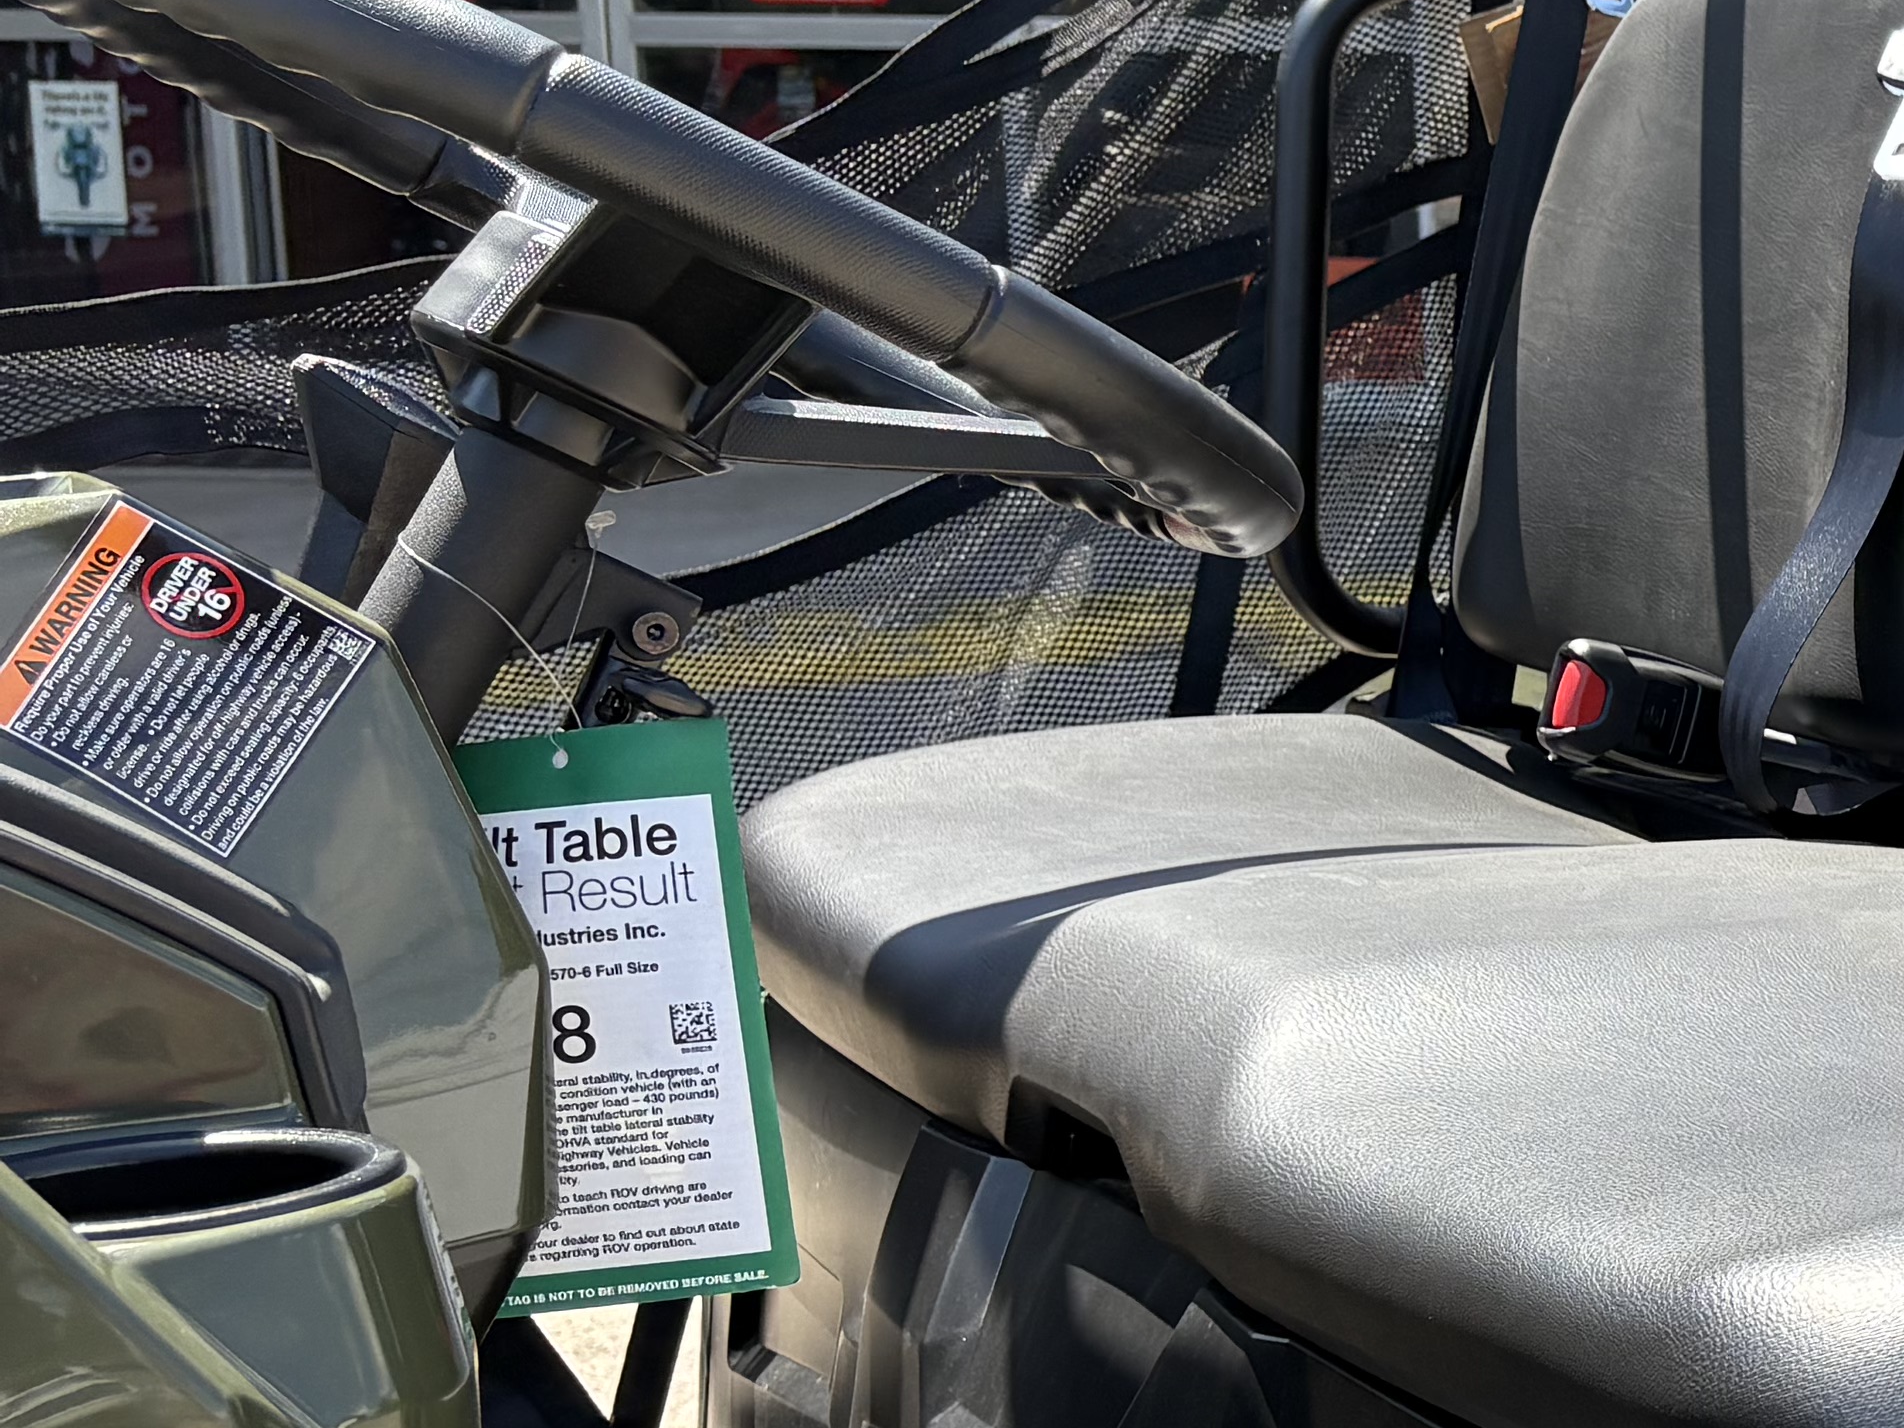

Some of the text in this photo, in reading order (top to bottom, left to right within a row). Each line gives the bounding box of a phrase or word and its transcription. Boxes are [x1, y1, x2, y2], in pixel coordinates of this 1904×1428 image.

[30, 547, 122, 655] WARNING
[149, 556, 197, 612] DRIVER
[170, 567, 215, 620] UNDER
[198, 589, 230, 619] 16
[14, 555, 144, 732] Require Proper Use of Your Vehicle
[30, 602, 133, 741] Do your part to prevent injuries:
[53, 634, 132, 741] Do not allow careless or
[146, 595, 292, 797] Do not allow operation on public roads (unless
[72, 677, 128, 750] reckless driving.
[84, 638, 175, 761] Make sure operators are 16
[103, 648, 191, 770] or older with valid driver's
[116, 653, 209, 779] license. Do not let people
[133, 613, 260, 787] drive or ride after using alcohol or drugs.
[164, 616, 301, 805] designated for off-highway vehicle access)
[179, 634, 309, 815] collisions with cars and trucks can occur.
[191, 626, 340, 824] Do not exceed seating capacity: 6 occupants.
[201, 654, 337, 840] Driving on public roads may be hazardous
[218, 698, 330, 849] and could be violation of the law.
[492, 815, 678, 867] lt Table
[541, 861, 698, 914] Result
[537, 923, 665, 947] ustries Inc.
[550, 961, 658, 980] 570-6 Full Size
[559, 1077, 716, 1099] condition vehicle (with an
[582, 1072, 632, 1084] stability,
[707, 1062, 719, 1073] of
[602, 1087, 718, 1107] load 430 pounds)
[566, 1106, 663, 1122] manufacturer in
[571, 1114, 714, 1135] tilt table lateral stability
[594, 1130, 668, 1145] standard for
[607, 1138, 709, 1156] Vehicles. Vehicle
[612, 1151, 711, 1168] and loading can
[572, 1182, 706, 1202] teach ROV driving are
[613, 1191, 732, 1210] contact your dealer
[540, 1238, 695, 1261] regarding ROV operation.
[561, 1220, 739, 1246] dealer to find out about state
[507, 1295, 530, 1305] TAG
[533, 1293, 545, 1303] IS
[548, 1290, 573, 1301] NOT
[577, 1288, 595, 1298] TO
[618, 1279, 678, 1293] REMOVED
[681, 1274, 731, 1287] BEFORE
[734, 1269, 768, 1282] SALE.
